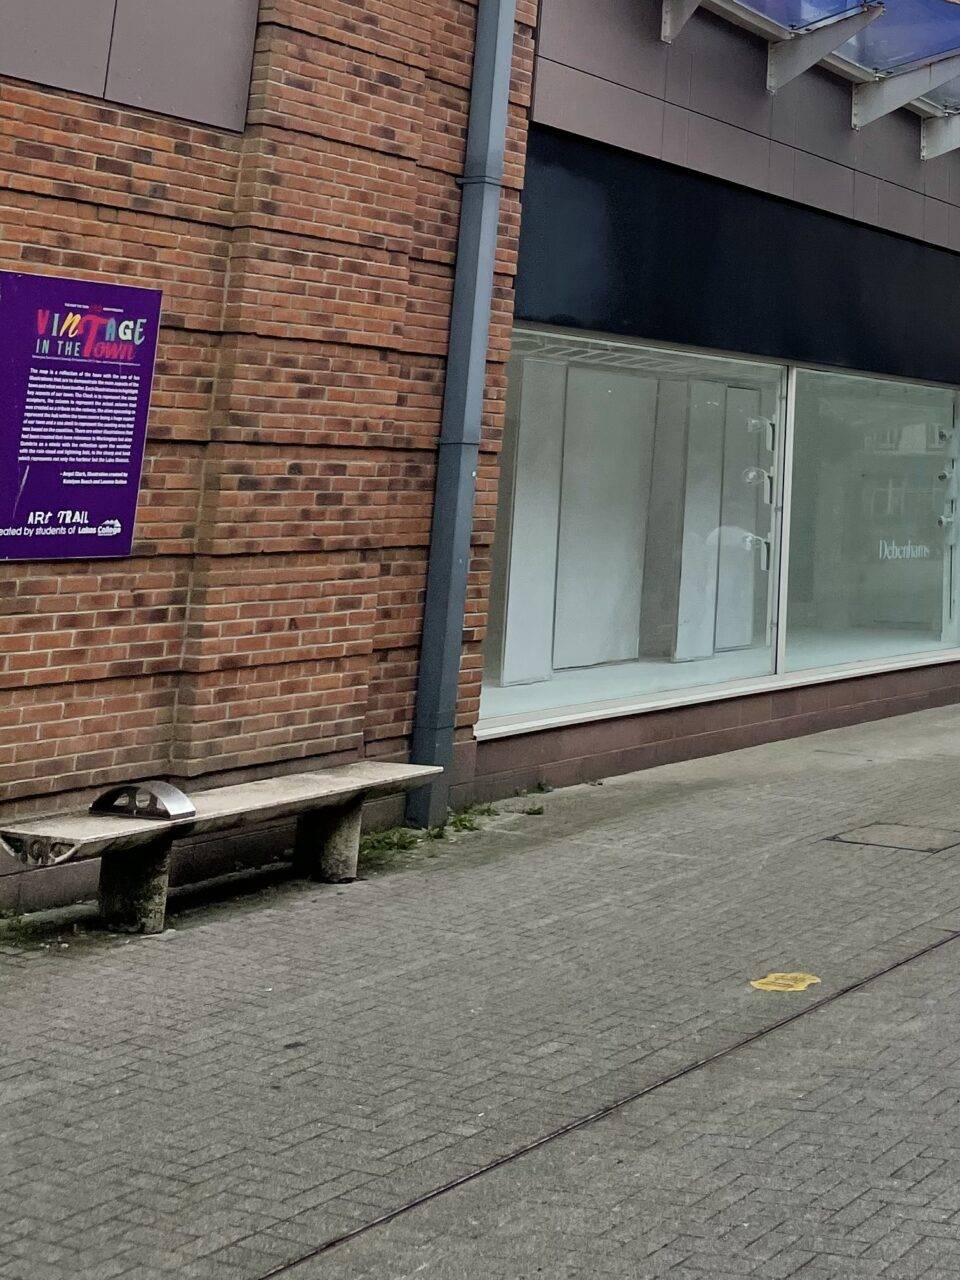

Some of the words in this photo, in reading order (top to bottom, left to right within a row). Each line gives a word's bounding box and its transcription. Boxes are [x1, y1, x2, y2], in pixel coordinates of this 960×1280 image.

[35, 339, 50, 354] IN
[57, 340, 81, 356] THE
[57, 509, 89, 524] TRAIL
[0, 526, 23, 536] eated
[23, 526, 35, 538] by
[35, 526, 67, 536] students
[67, 525, 77, 535] of
